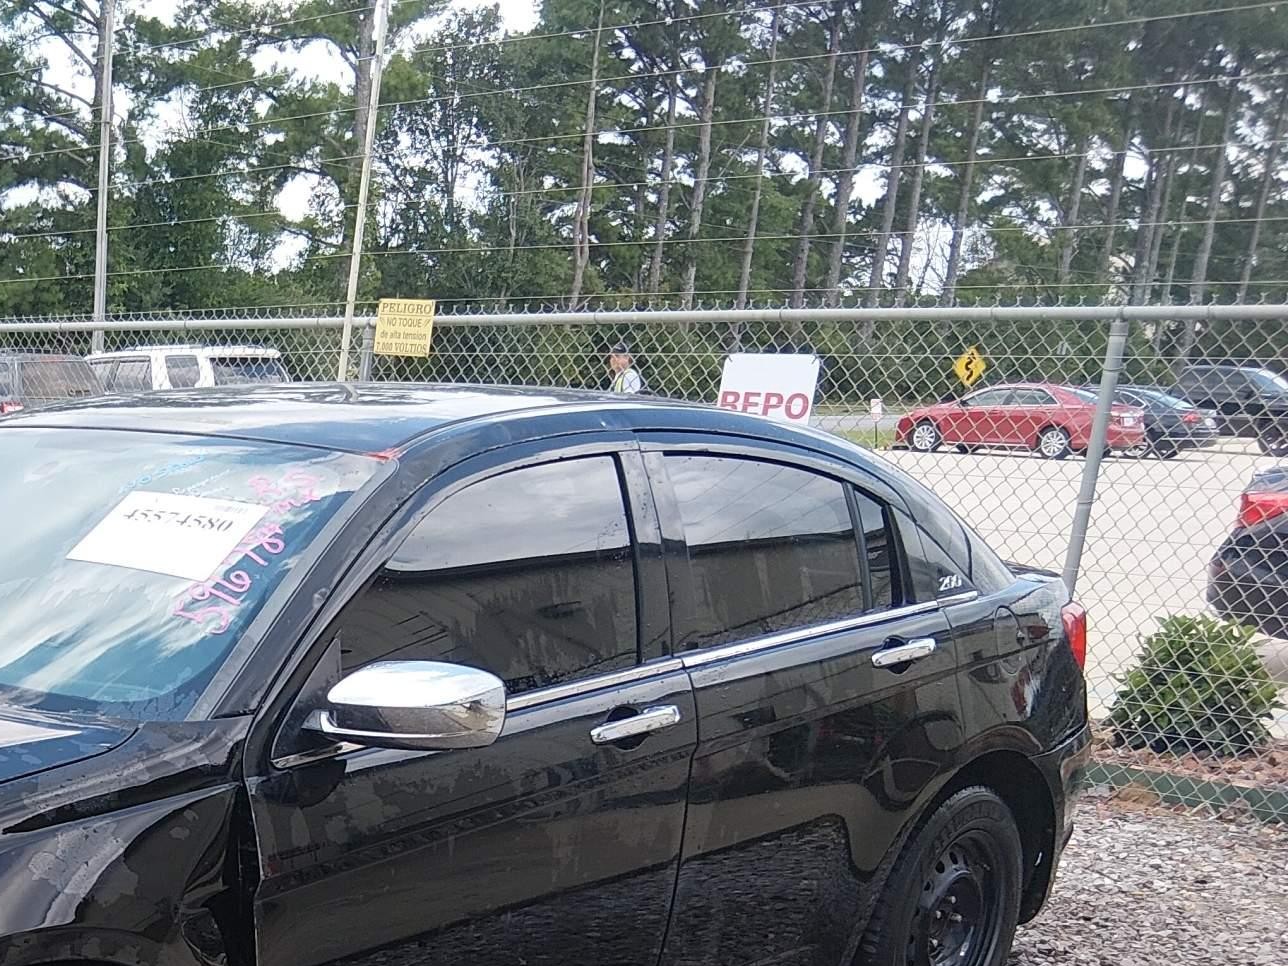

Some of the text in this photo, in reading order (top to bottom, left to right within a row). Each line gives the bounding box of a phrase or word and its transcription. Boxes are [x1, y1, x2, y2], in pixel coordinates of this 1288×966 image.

[381, 303, 432, 315] PELIGRO
[386, 317, 422, 328] NO TOQUE
[395, 342, 427, 353] VOLTIOS
[719, 390, 810, 420] REPO
[123, 508, 234, 533] 45574580
[938, 574, 962, 592] 200
